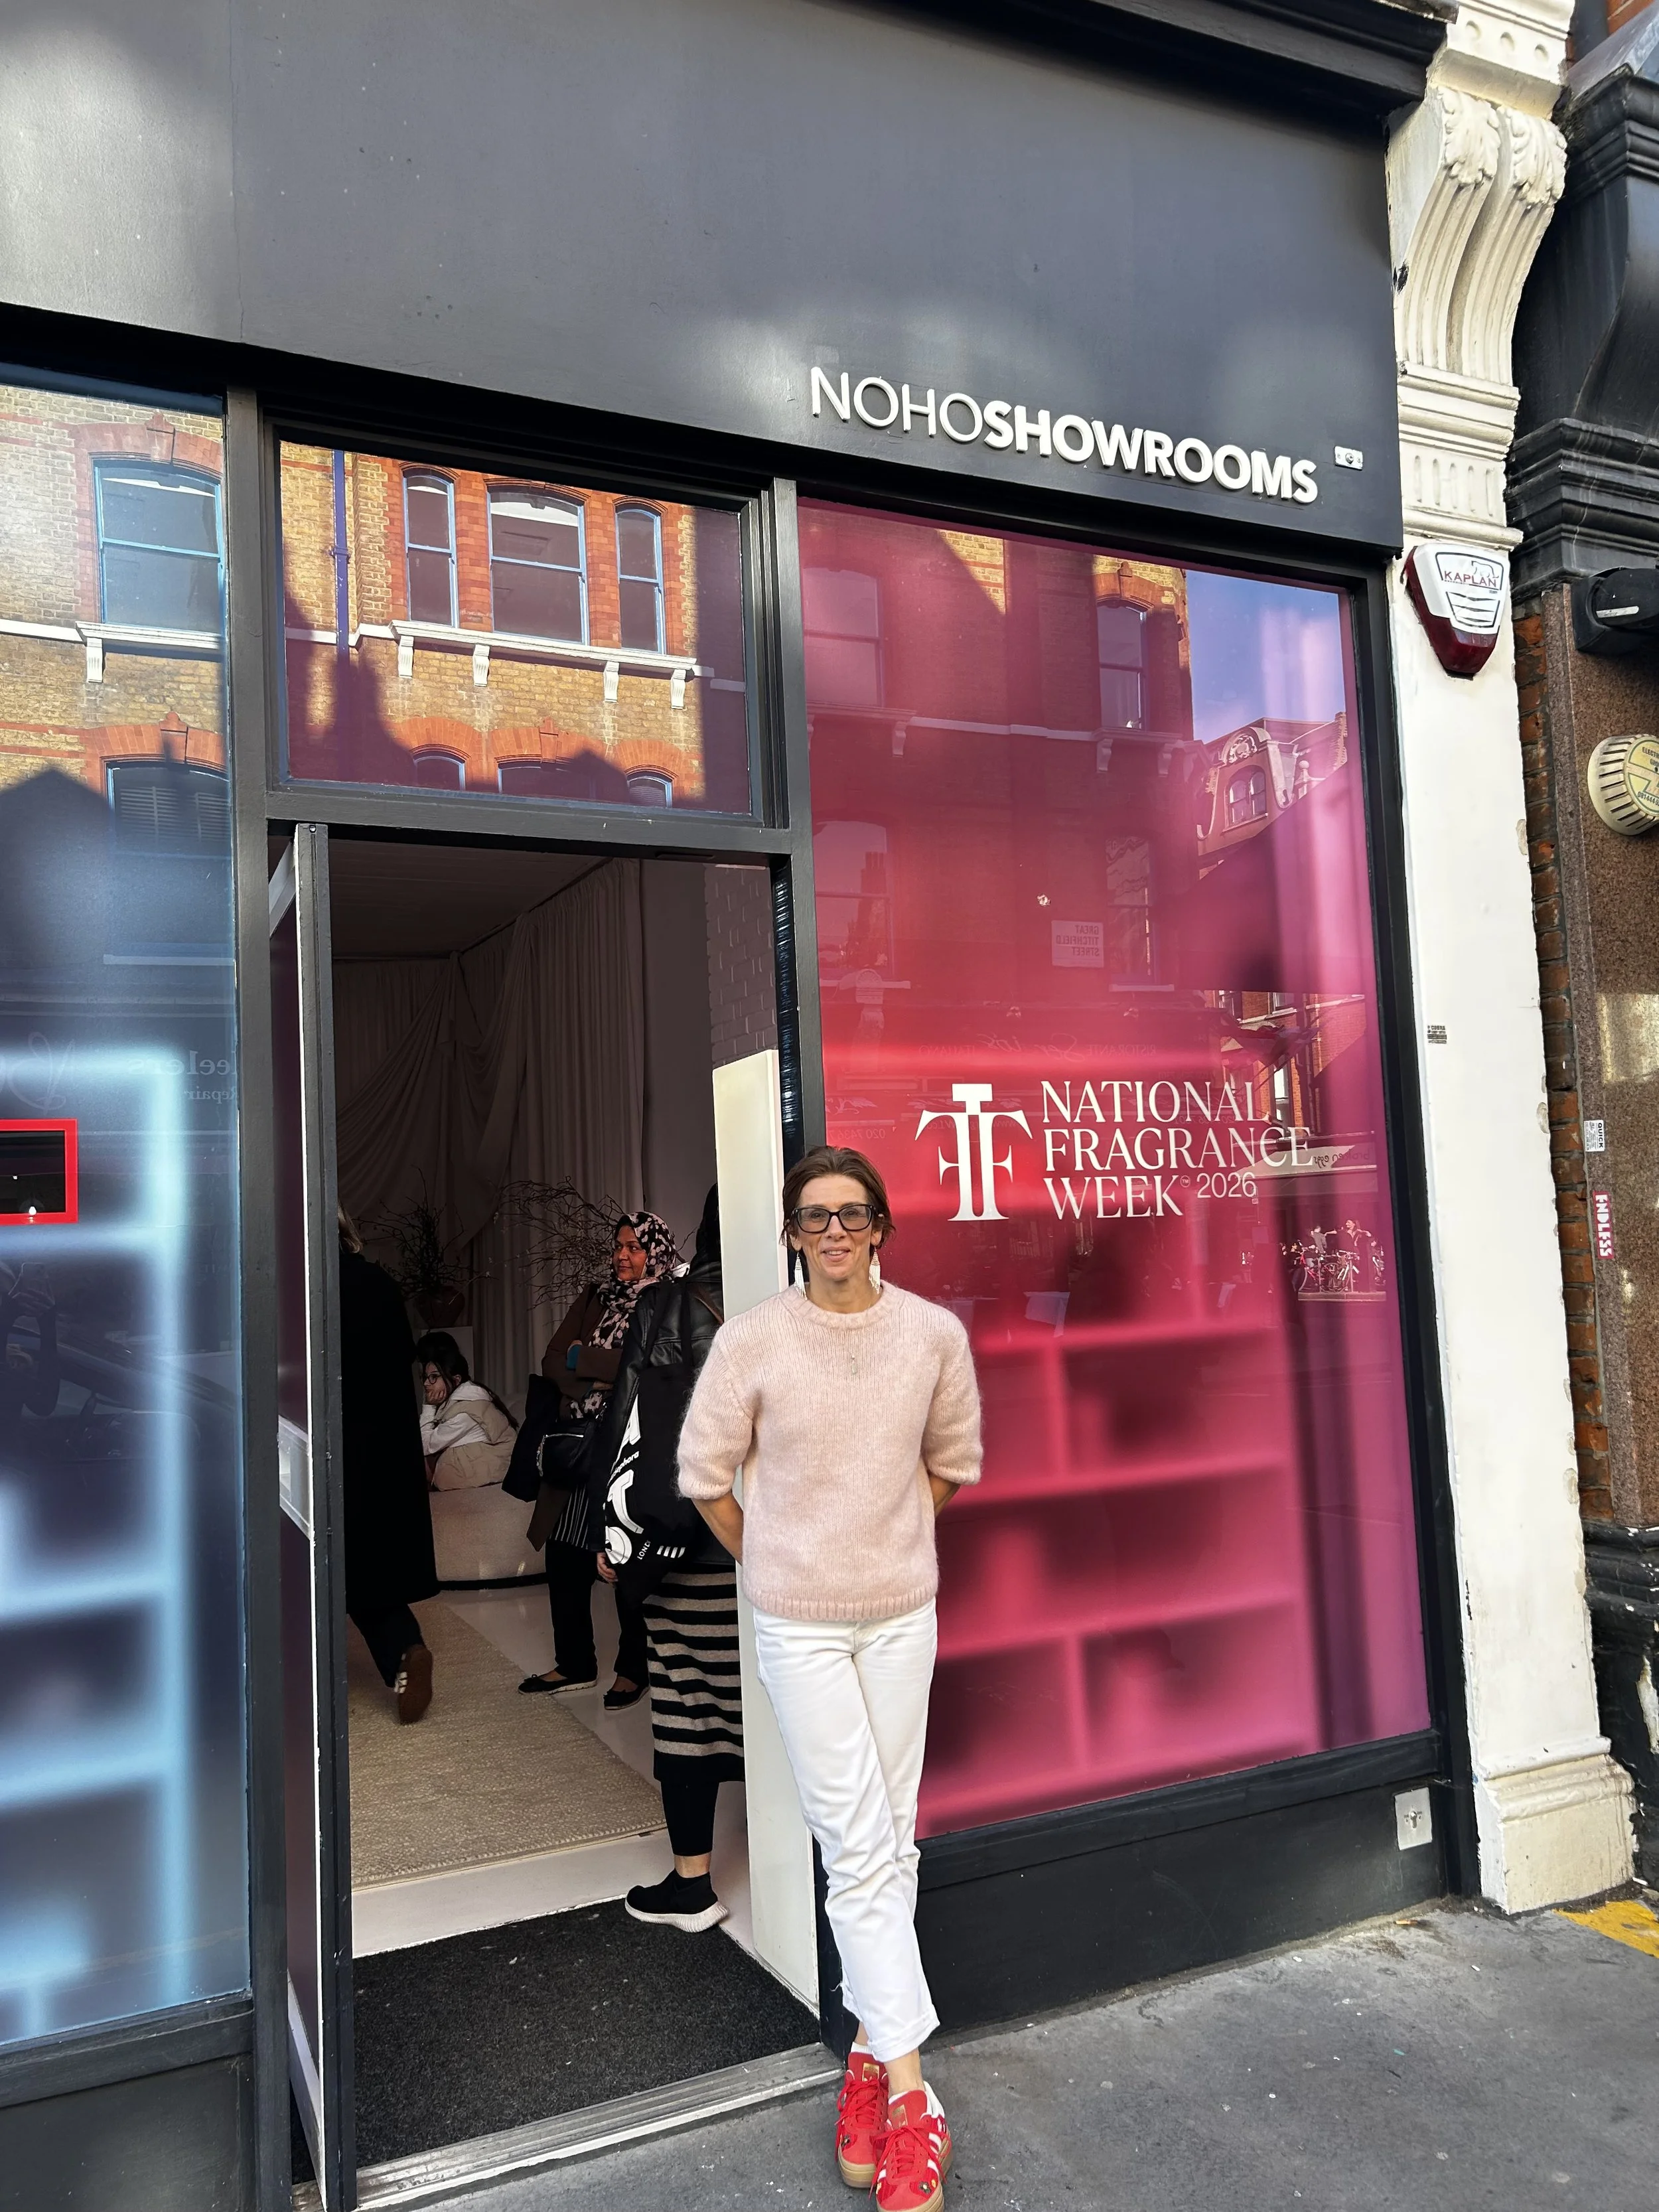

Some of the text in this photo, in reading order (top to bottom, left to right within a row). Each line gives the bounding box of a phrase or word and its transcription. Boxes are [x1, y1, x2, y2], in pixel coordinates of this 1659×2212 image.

[1444, 571, 1496, 587] KAPLAN
[1042, 1080, 1270, 1123] NATIONAL
[1044, 1126, 1314, 1172] FRAGRANCE
[1043, 1176, 1183, 1220] WEEK
[1197, 1173, 1257, 1199] 2026
[1595, 1195, 1612, 1256] ENDLESS
